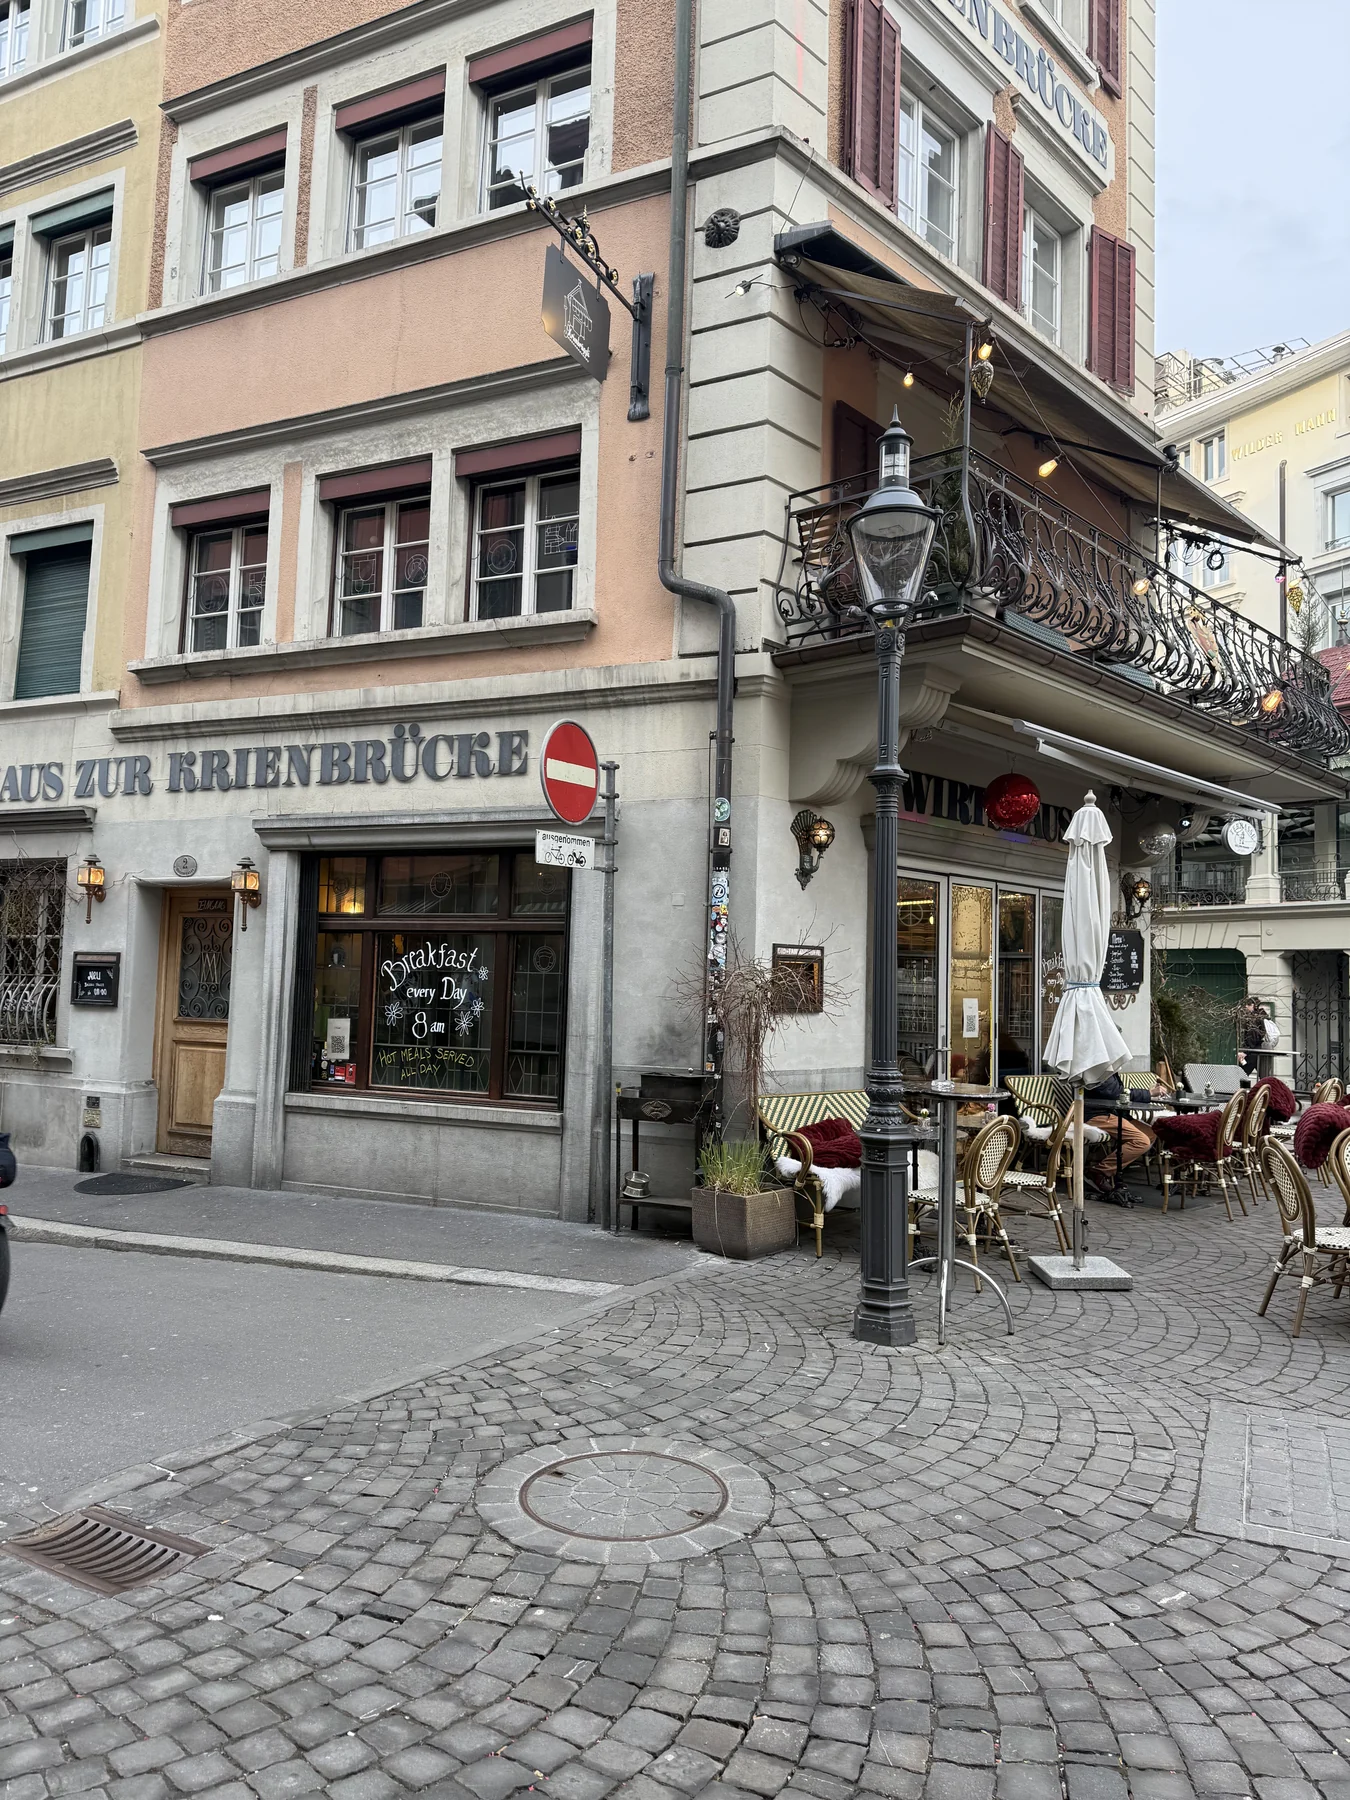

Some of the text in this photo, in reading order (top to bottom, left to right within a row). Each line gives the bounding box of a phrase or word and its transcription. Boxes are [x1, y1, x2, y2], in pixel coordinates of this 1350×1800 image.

[1294, 408, 1336, 436] MANN
[0, 723, 529, 802] AUS ZUR KRIENBRÜCKE
[900, 769, 1073, 845] WIRTAUS
[541, 833, 591, 847] ausgenommen
[182, 857, 188, 869] 2
[381, 941, 478, 991] Breakfast
[1041, 952, 1065, 977] Breakfa
[406, 976, 467, 1010] every Day
[1048, 992, 1054, 1004] 8
[412, 1011, 445, 1039] 8 am
[378, 1047, 475, 1067] HOT MEALS SERVED
[400, 1064, 441, 1080] ALL DAY
